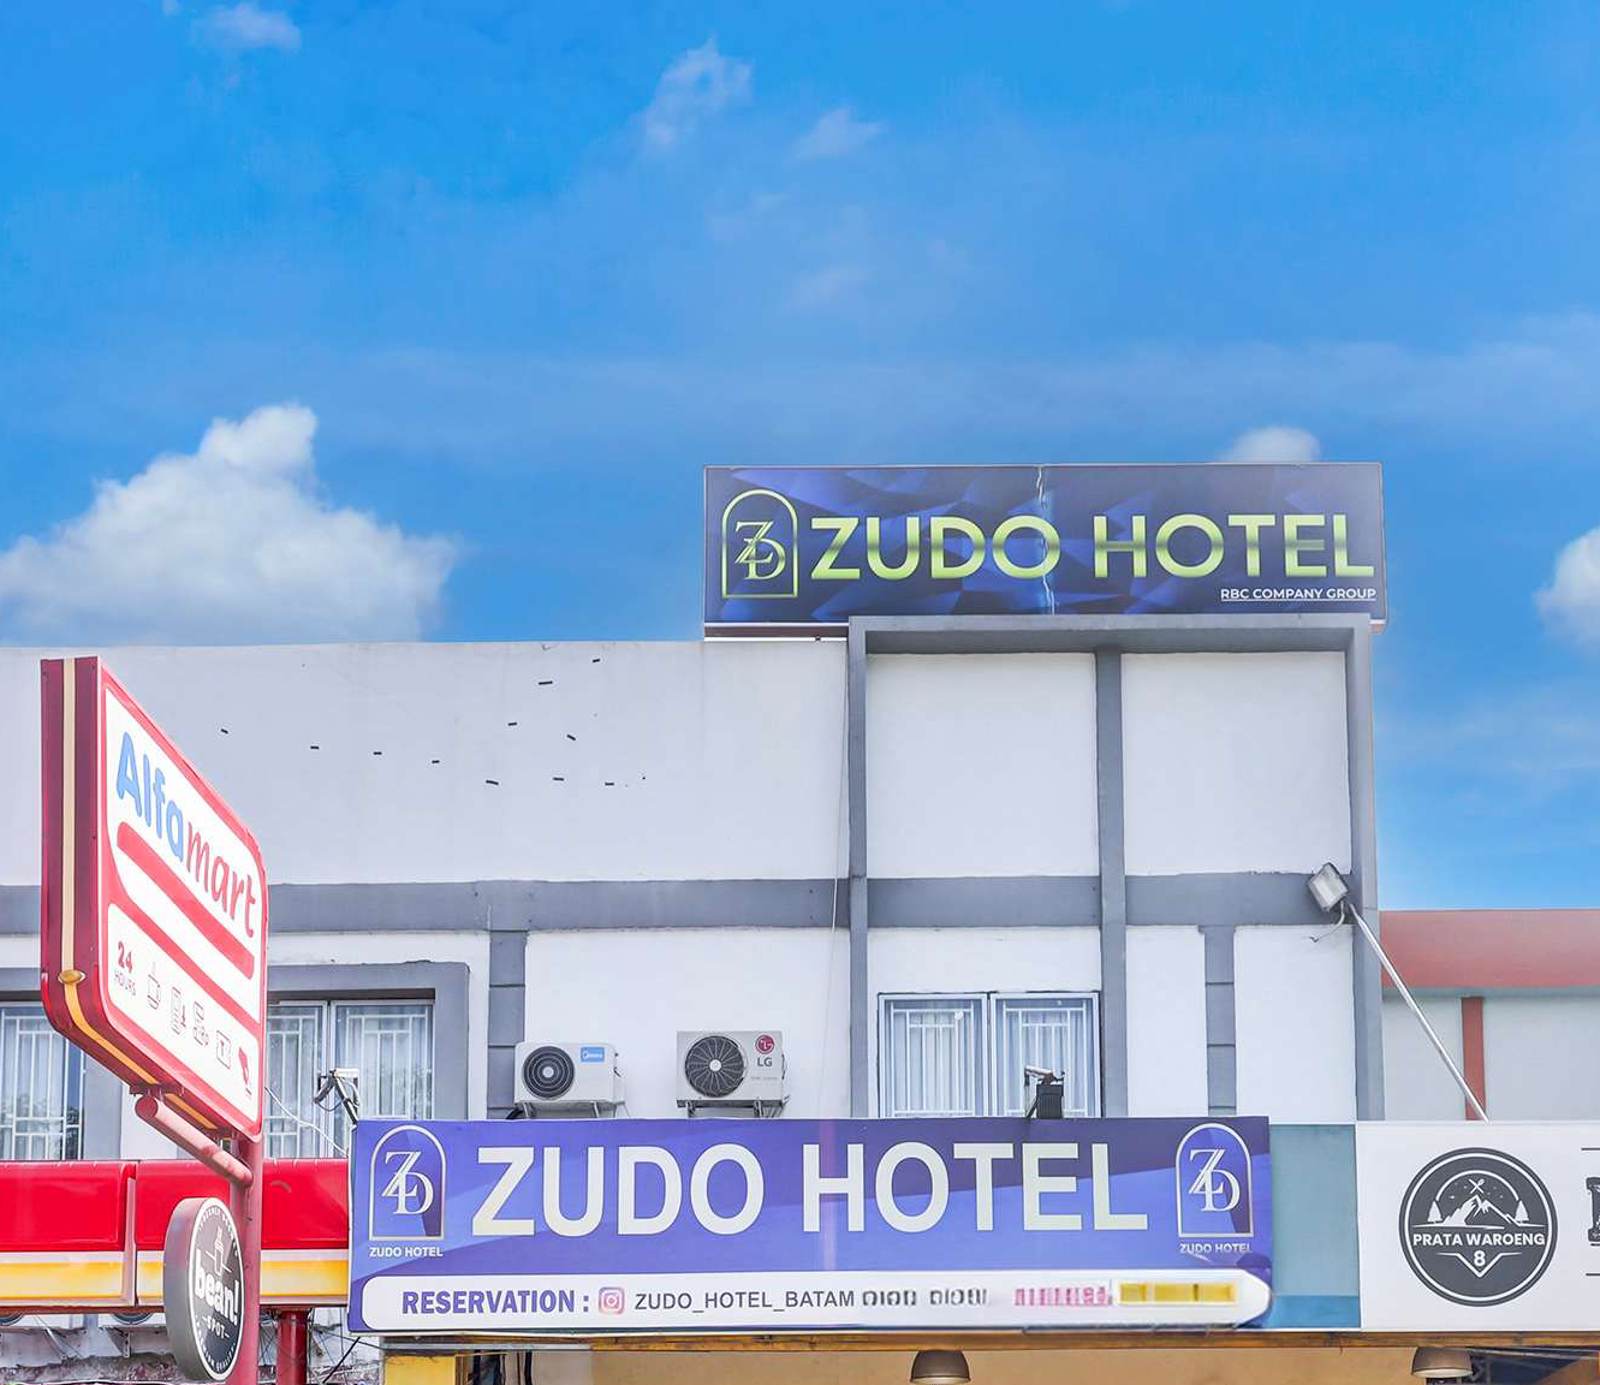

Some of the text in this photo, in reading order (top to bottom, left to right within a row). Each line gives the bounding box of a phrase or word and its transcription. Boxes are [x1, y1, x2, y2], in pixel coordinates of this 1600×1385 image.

[811, 513, 1374, 580] ZUDO HOTEL
[1220, 588, 1377, 599] RBC COMPANY GROUP
[116, 731, 256, 939] Alfamart
[118, 941, 133, 974] 24
[757, 1056, 773, 1068] LG
[472, 1141, 1148, 1237] ZUDO HOTEL
[1179, 1242, 1253, 1254] ZUDO HOTEL
[1413, 1232, 1546, 1246] PRATA WAROENG
[369, 1246, 444, 1258] ZUDO HOTEL
[1473, 1249, 1487, 1267] 8
[194, 1249, 240, 1326] bean!
[402, 1290, 575, 1314] RESERVATION
